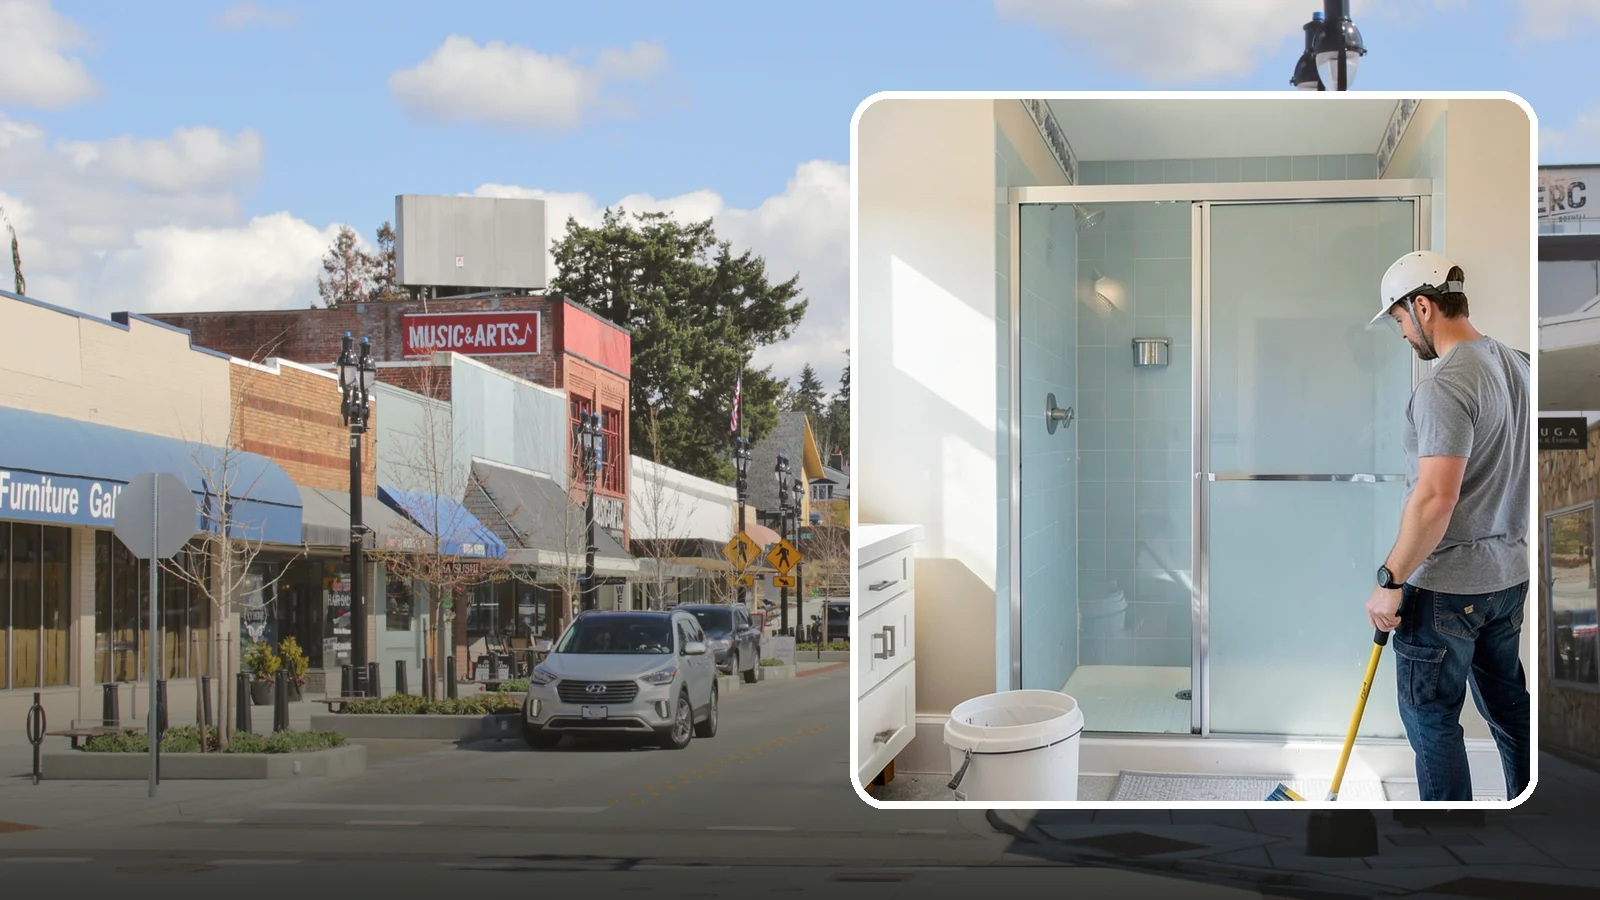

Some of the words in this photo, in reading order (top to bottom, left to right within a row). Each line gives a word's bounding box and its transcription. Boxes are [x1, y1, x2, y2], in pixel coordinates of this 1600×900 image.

[409, 323, 519, 349] MUSIC&ARTS
[0, 472, 79, 515] Furniture
[89, 482, 122, 519] Gal
[453, 563, 479, 574] SUSHI
